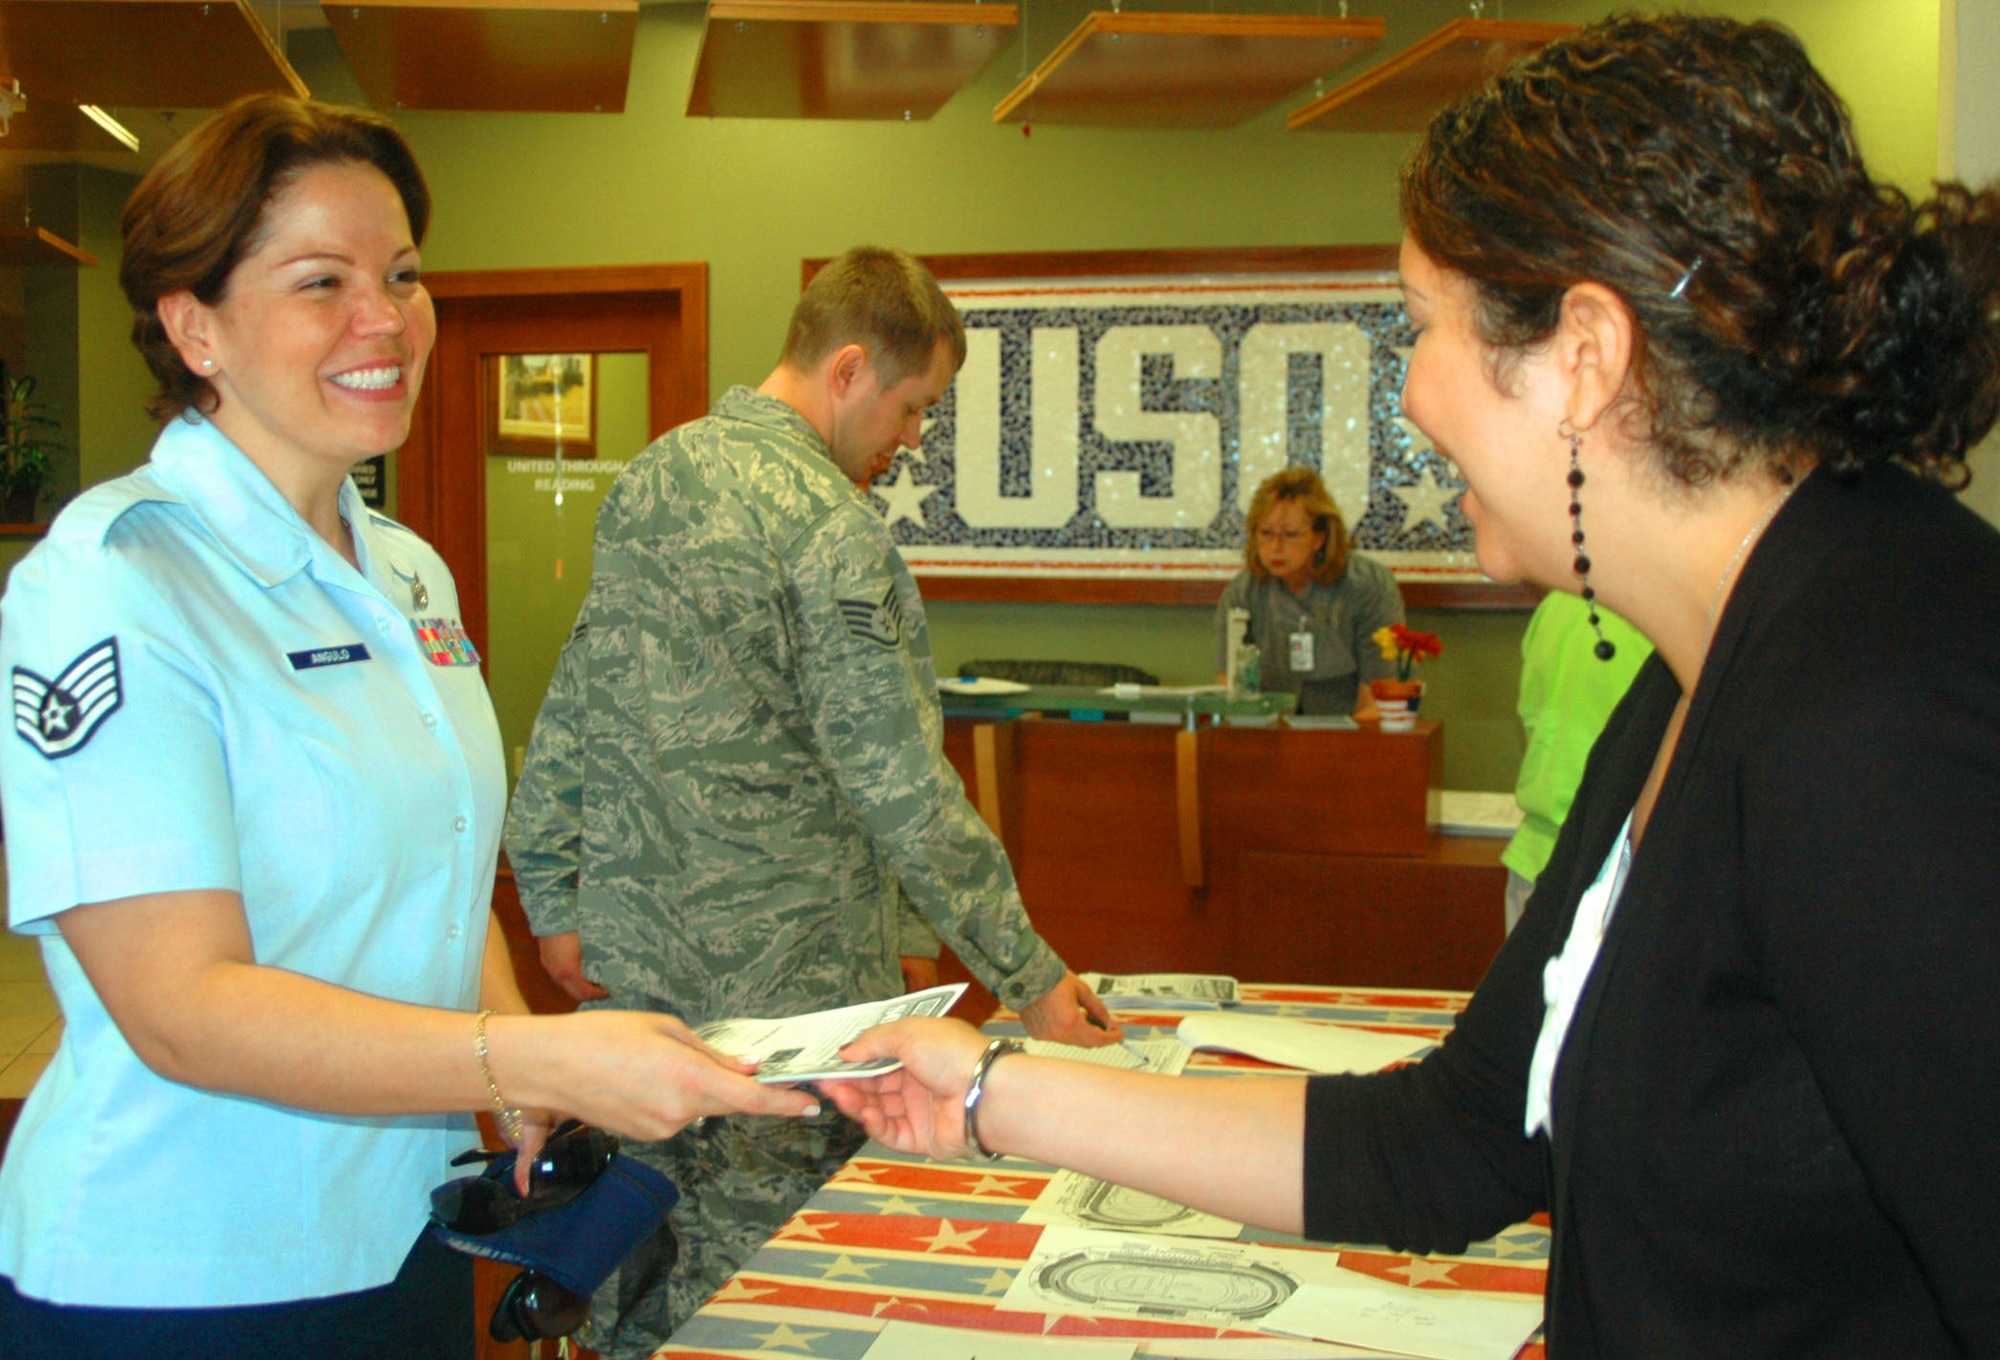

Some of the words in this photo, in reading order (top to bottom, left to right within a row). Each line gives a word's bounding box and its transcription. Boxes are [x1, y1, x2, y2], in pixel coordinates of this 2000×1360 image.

[955, 322, 1371, 530] USO
[507, 461, 556, 473] UNITED
[561, 460, 622, 473] THROUGH
[534, 479, 595, 491] READING
[312, 648, 350, 664] ANGULO
